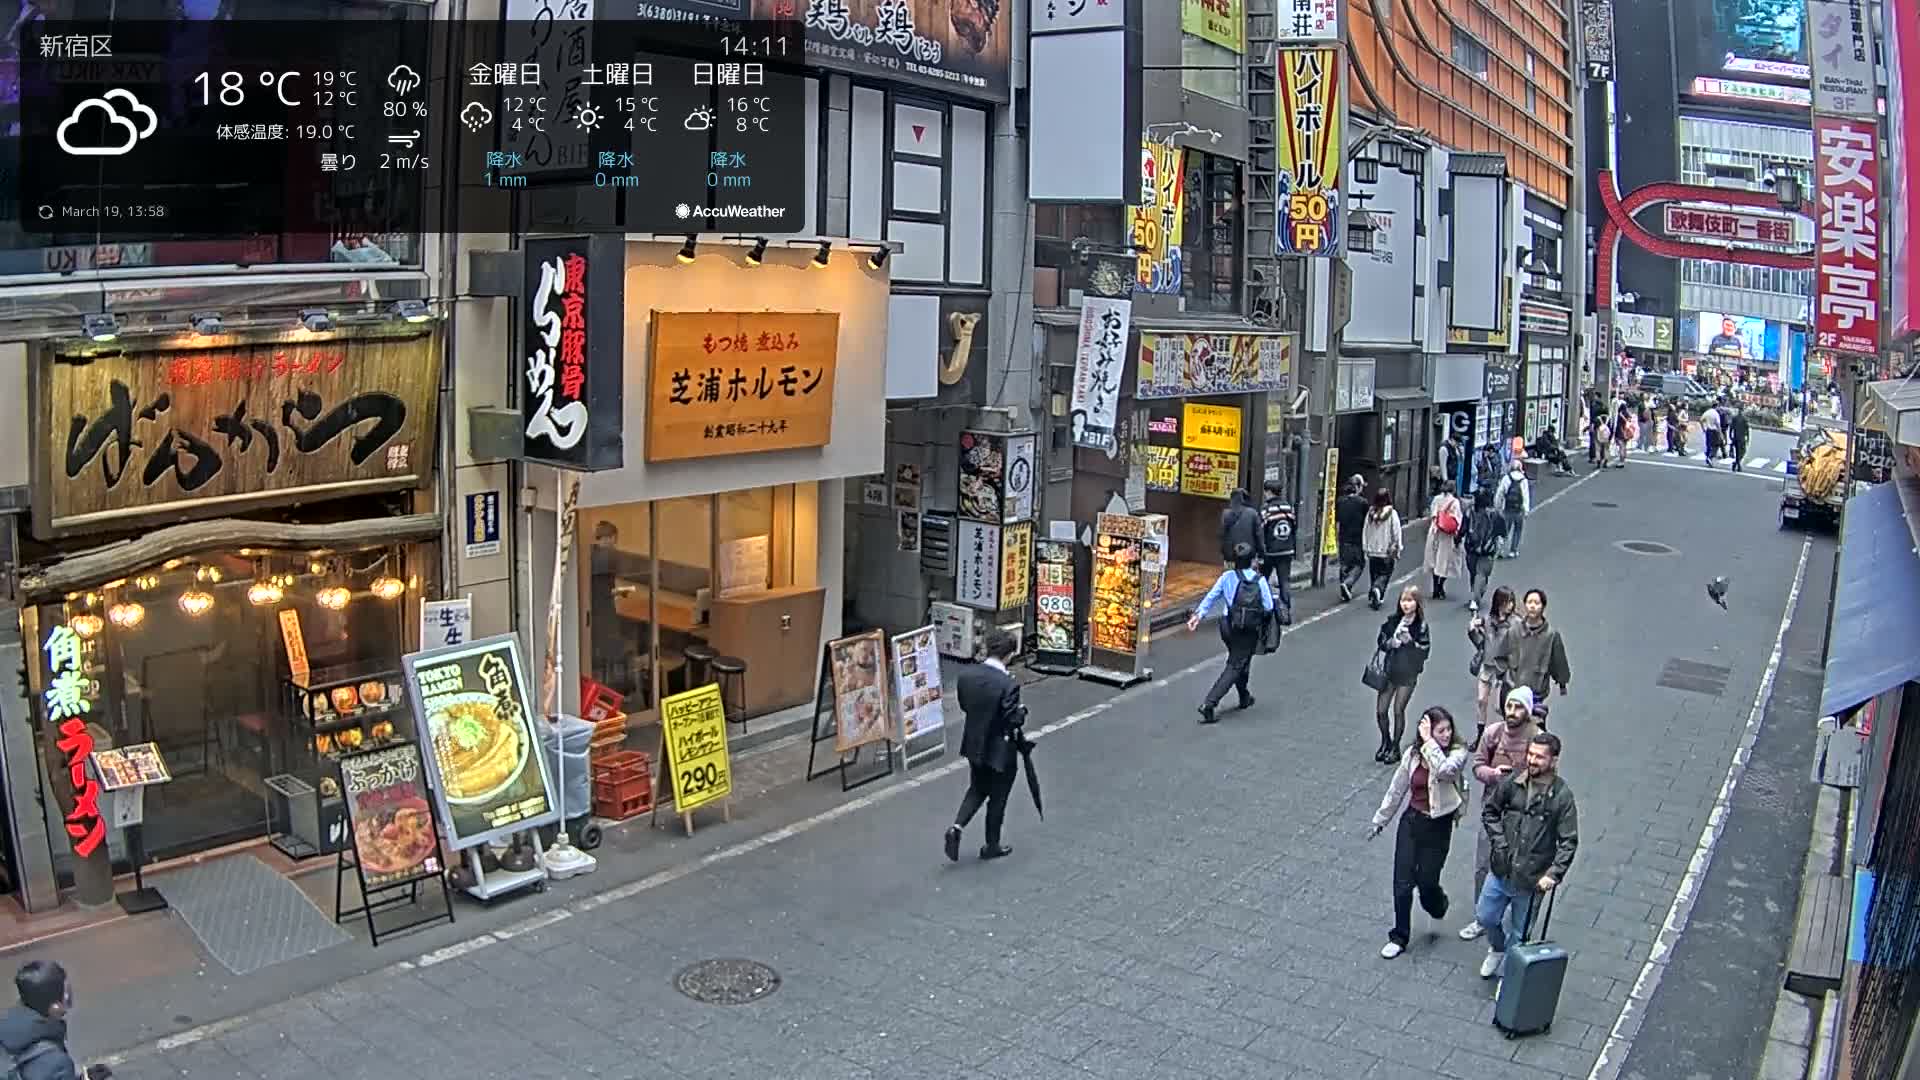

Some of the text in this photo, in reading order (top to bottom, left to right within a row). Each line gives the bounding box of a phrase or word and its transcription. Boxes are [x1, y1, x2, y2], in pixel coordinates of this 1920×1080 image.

[1849, 0, 1867, 62] 理専門店
[1590, 62, 1610, 77] 7F
[1833, 96, 1856, 111] 3F
[1294, 52, 1323, 191] ハイボール
[1161, 150, 1177, 286] ハイボール
[1671, 210, 1790, 242] 歌舞伎町一番街
[1820, 125, 1878, 330] 安楽亭
[560, 252, 587, 400] 東京豚骨
[703, 331, 801, 354] もつ焼 煮込み
[1818, 331, 1837, 347] 2F
[669, 366, 825, 405] 芝浦ホルモン
[972, 526, 984, 600] 芝浦ホルモン
[1039, 596, 1073, 613] 980
[418, 663, 462, 685] TOKYO
[479, 653, 523, 720] 角煮
[670, 696, 718, 716] ハッピーアワー
[43, 624, 106, 858] 角煮ラーメン
[678, 726, 719, 748] ハイボール
